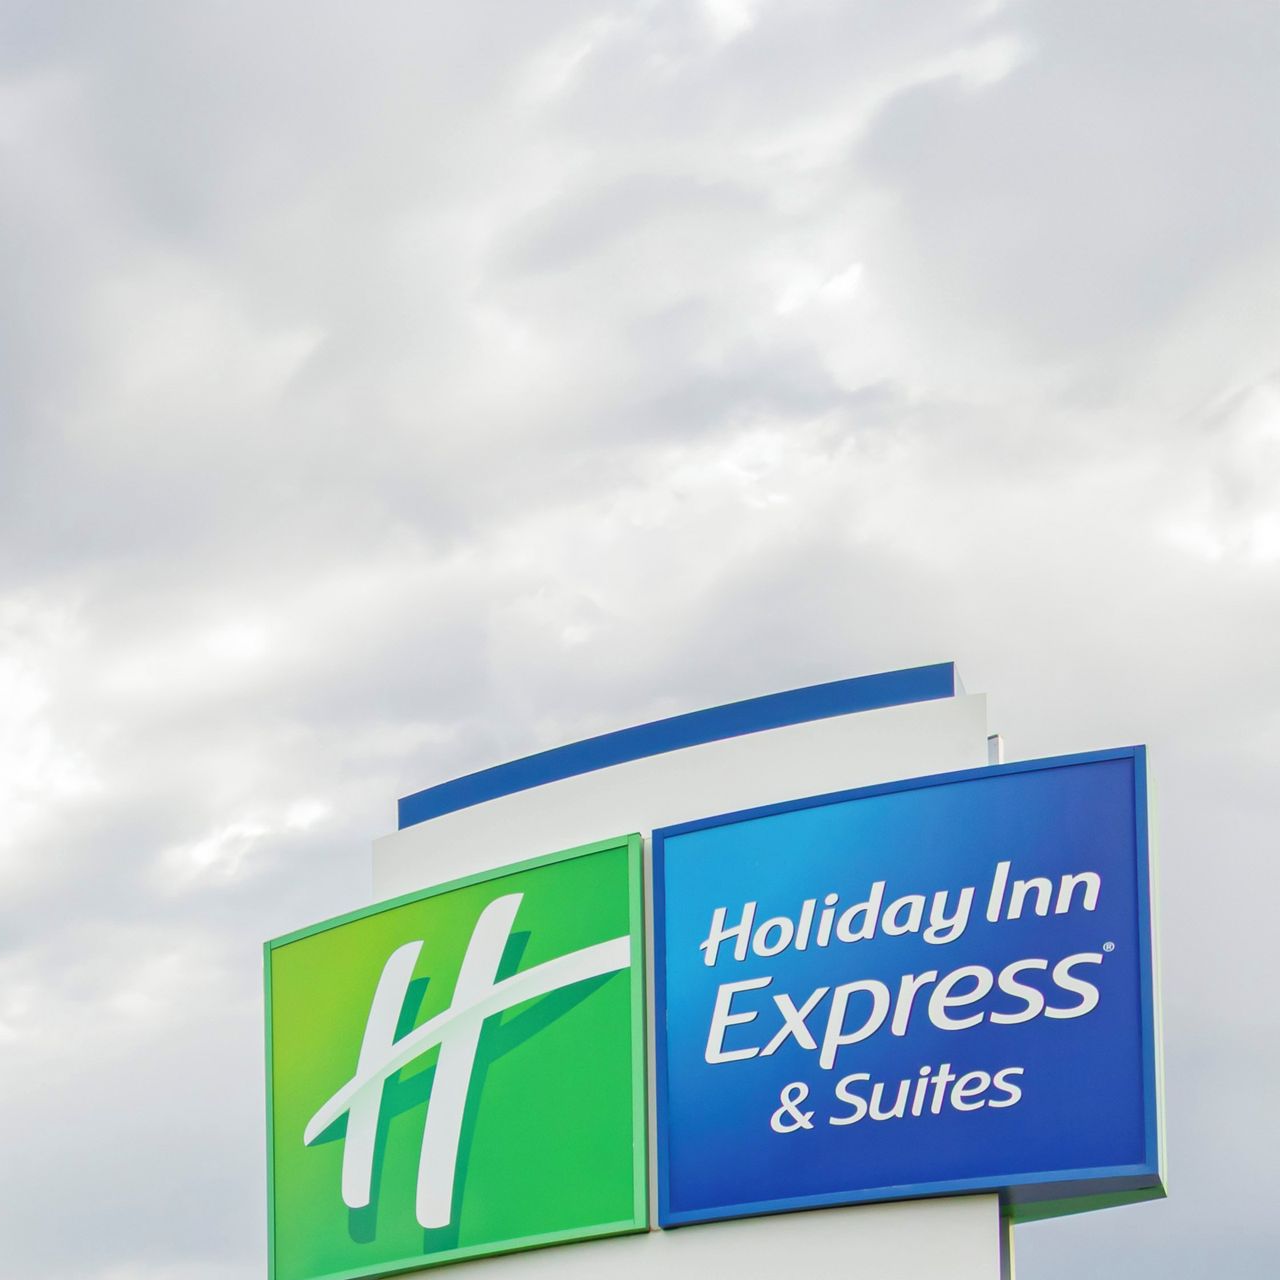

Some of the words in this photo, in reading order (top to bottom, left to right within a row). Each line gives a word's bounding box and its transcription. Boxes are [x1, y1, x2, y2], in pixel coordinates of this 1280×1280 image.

[699, 880, 975, 967] Holiday
[985, 861, 1101, 924] Inn
[770, 1081, 815, 1134] &
[829, 1063, 1025, 1126] Suites
